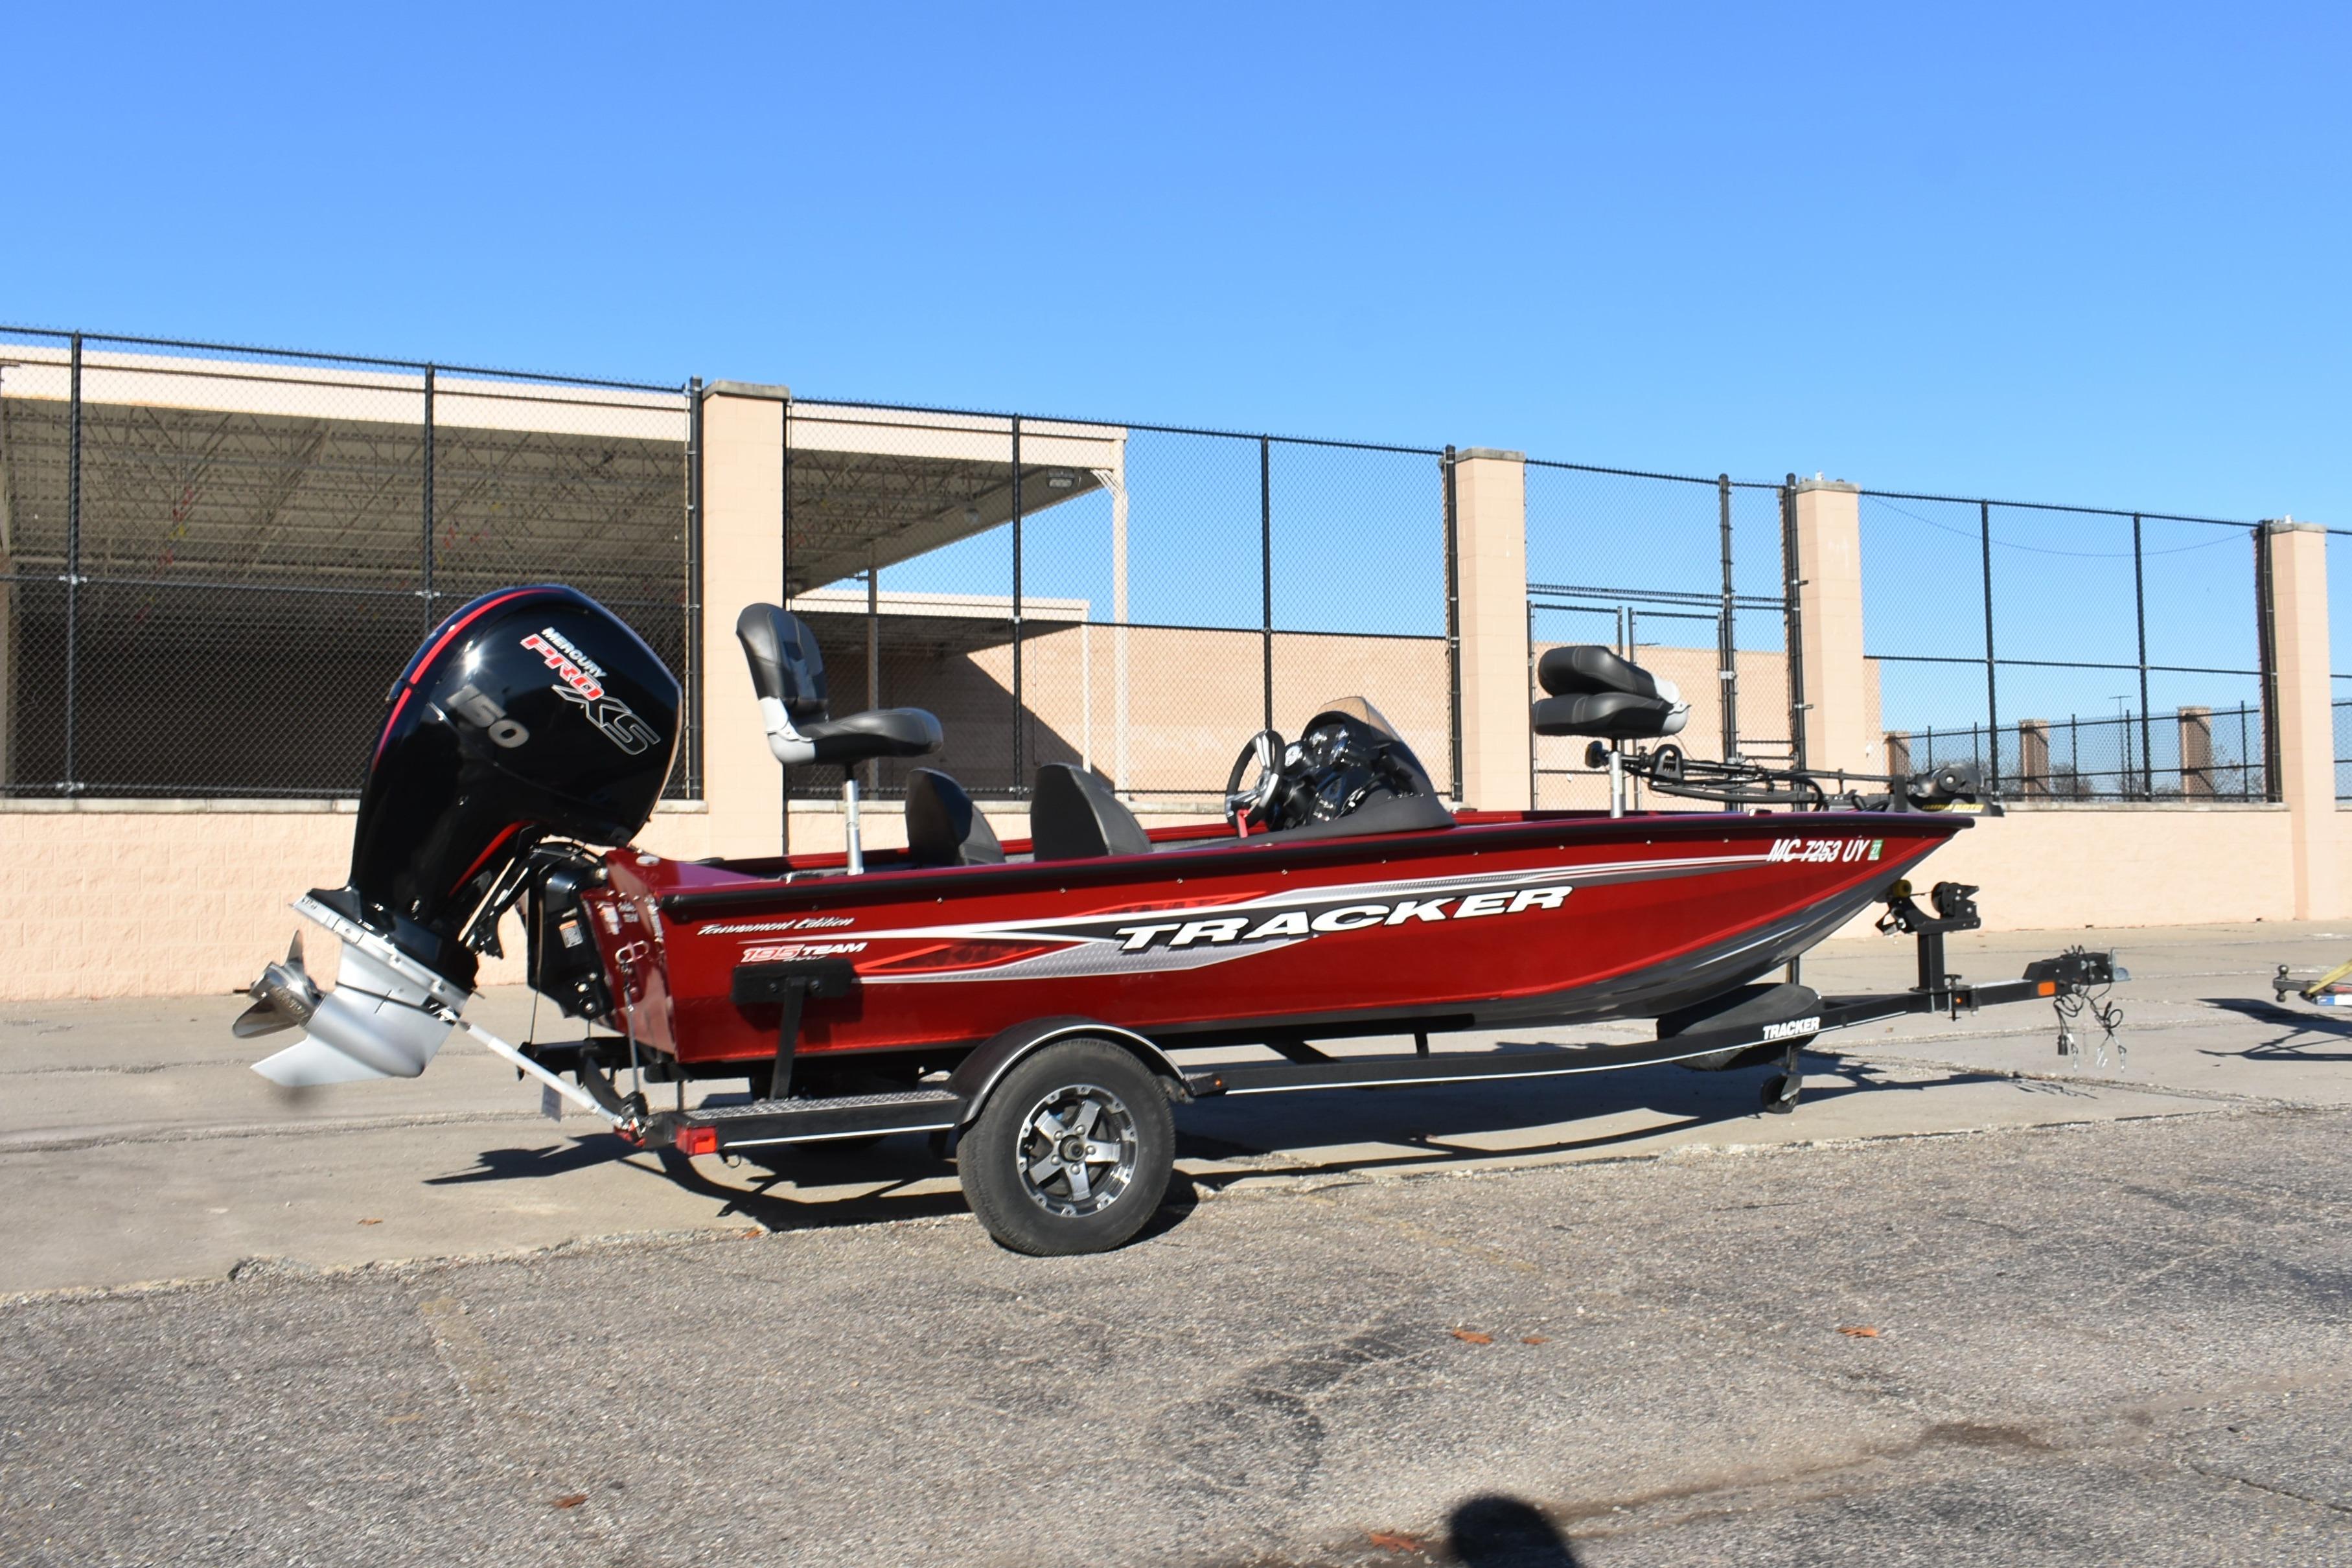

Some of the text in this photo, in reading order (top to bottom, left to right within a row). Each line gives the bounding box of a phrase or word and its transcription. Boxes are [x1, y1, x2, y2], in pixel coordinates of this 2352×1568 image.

[540, 627, 608, 678] MERCURY
[520, 633, 661, 755] PRO XS
[1766, 838, 1801, 862] MC
[1841, 839, 1871, 862] UY
[697, 916, 855, 935] Tournament Edition
[1115, 886, 1573, 951] TRACKER
[802, 942, 868, 955] TEAM
[1762, 1016, 1821, 1041] TRACKER
